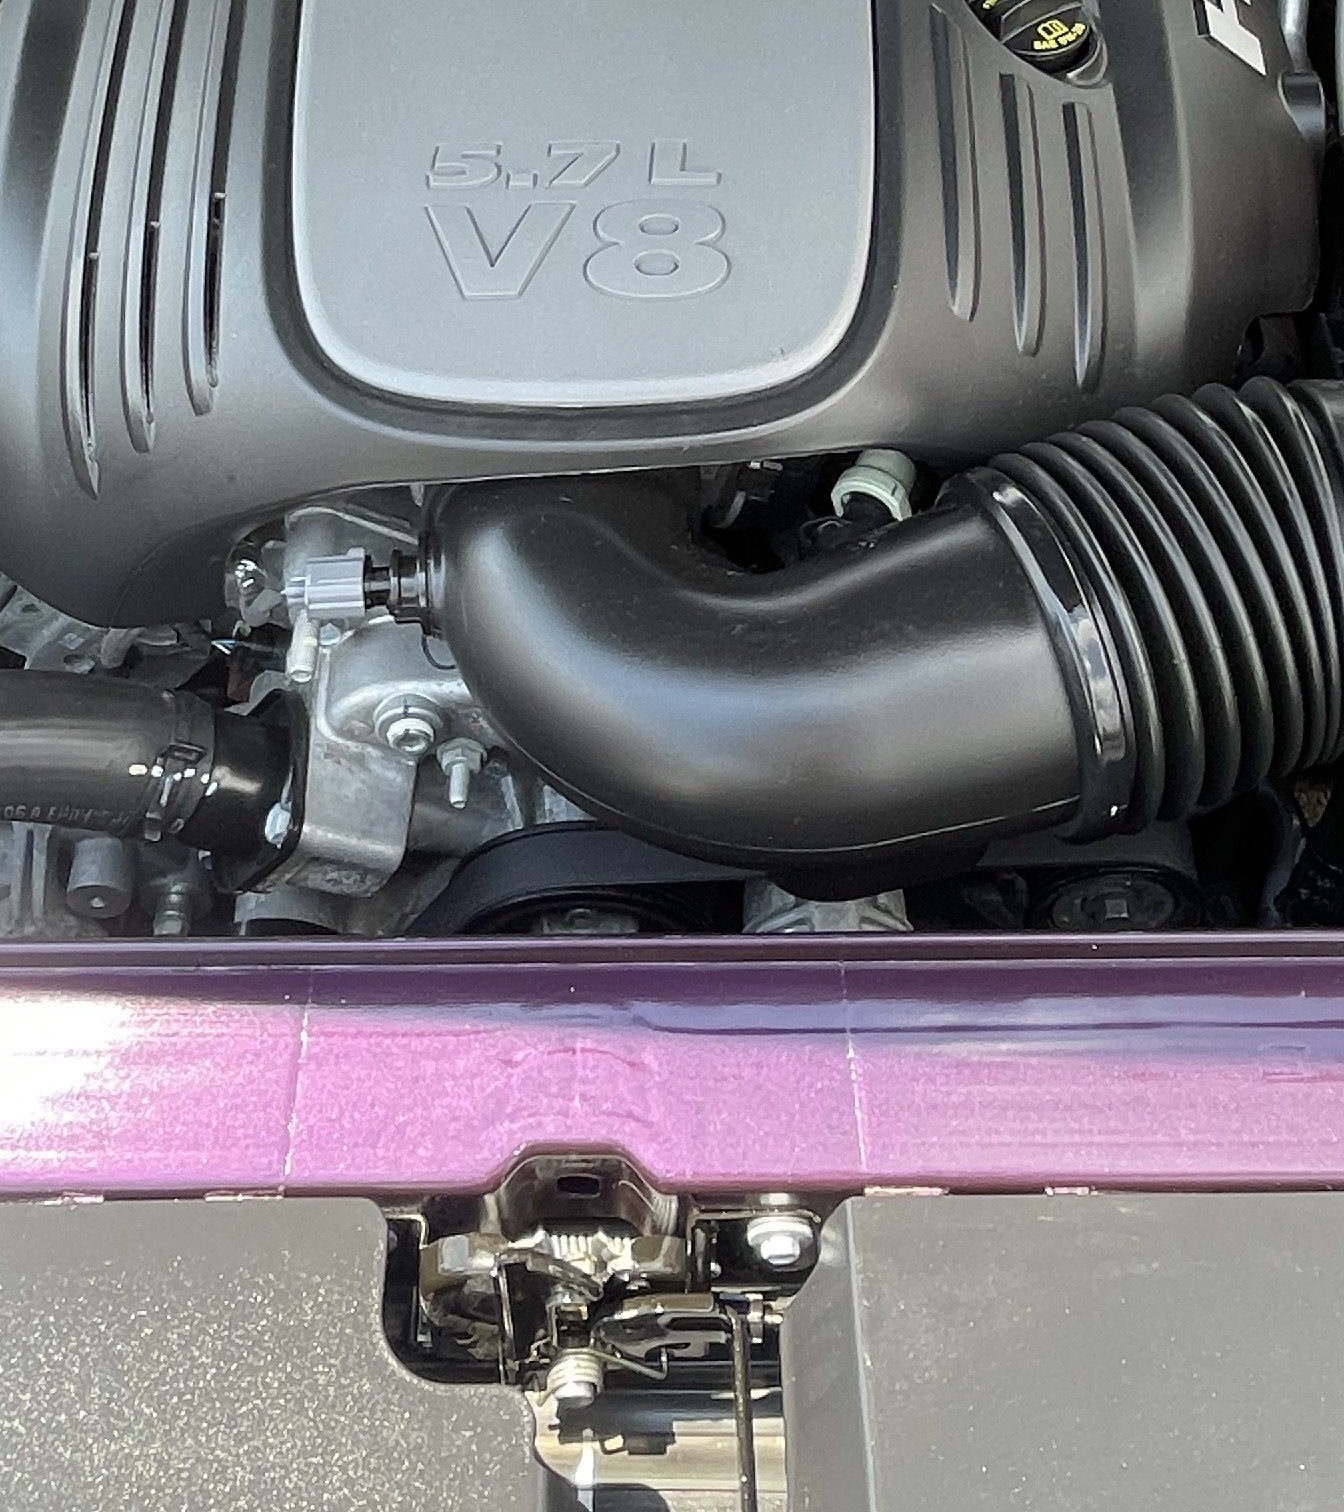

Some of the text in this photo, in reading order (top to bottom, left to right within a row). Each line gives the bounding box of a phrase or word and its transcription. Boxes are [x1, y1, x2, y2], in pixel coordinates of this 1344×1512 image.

[424, 139, 723, 189] 5.7 L
[423, 199, 732, 300] V8
